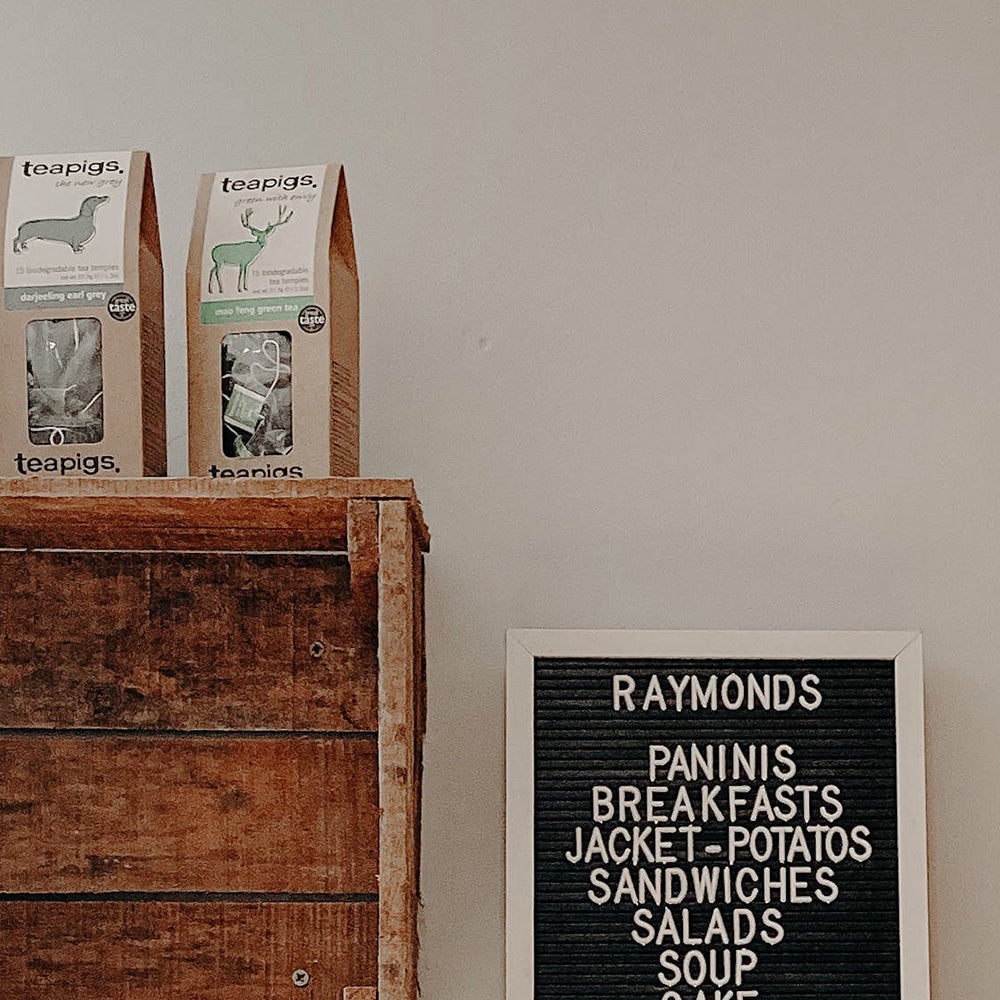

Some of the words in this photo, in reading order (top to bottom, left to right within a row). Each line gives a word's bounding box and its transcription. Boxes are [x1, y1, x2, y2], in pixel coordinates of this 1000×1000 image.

[22, 160, 124, 177] teapigs.
[95, 179, 123, 188] grey
[221, 174, 317, 193] teapigs.
[234, 197, 262, 208] green
[20, 290, 65, 302] darjeeling
[66, 290, 85, 300] earl
[86, 291, 107, 301] grey
[109, 303, 137, 313] taste
[235, 306, 255, 316] feng
[257, 305, 282, 316] green
[284, 303, 299, 312] tea
[300, 316, 326, 325] taste
[14, 453, 120, 476] teapigs.
[612, 673, 823, 711] RAYMONDS
[649, 743, 797, 781] PANINIS
[592, 785, 843, 823] BREAKFASTS
[565, 824, 872, 865] JACKET-POTATOS
[588, 865, 840, 905] SANDWICHES
[631, 906, 785, 946] SALADS
[657, 948, 758, 987] SOUP
